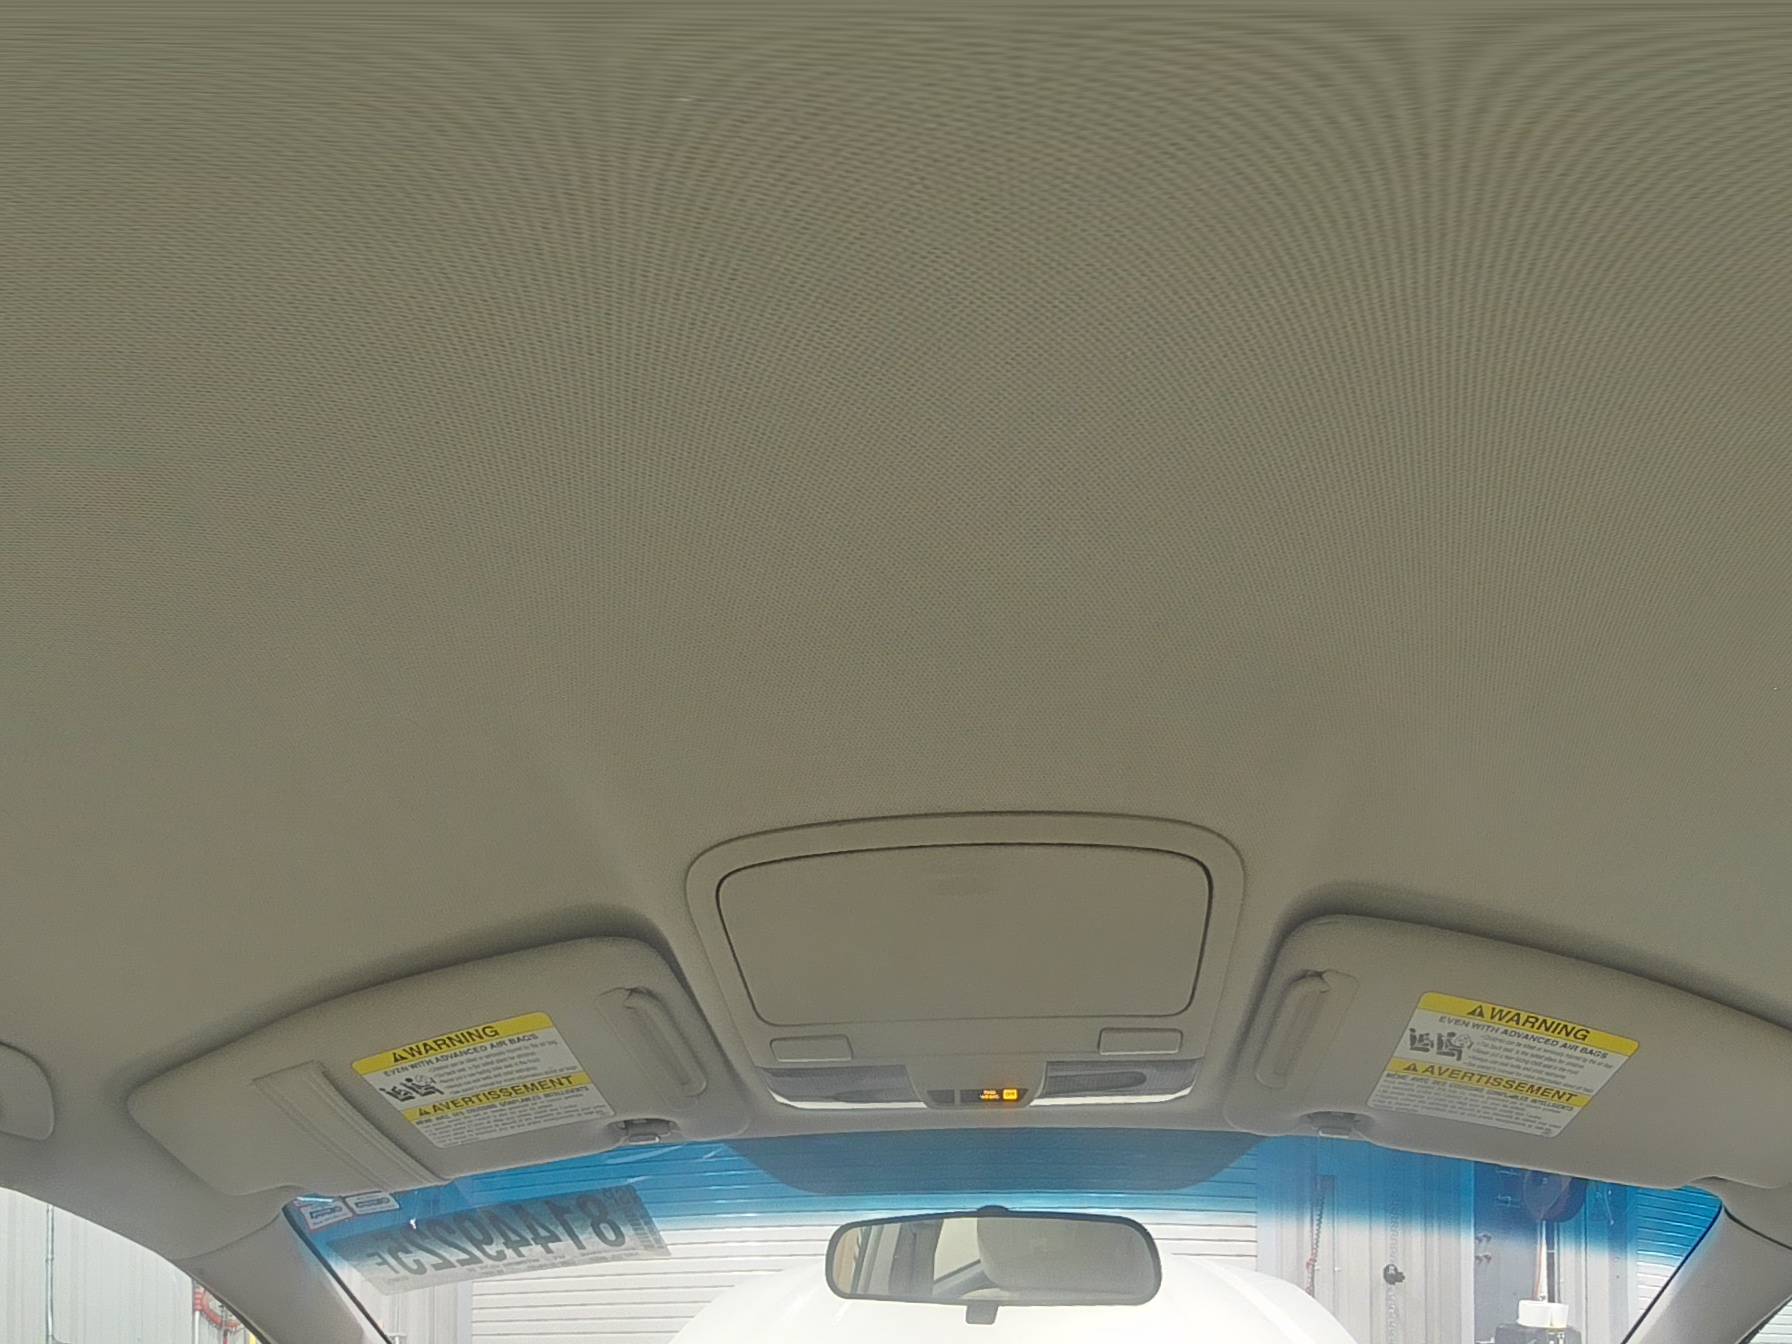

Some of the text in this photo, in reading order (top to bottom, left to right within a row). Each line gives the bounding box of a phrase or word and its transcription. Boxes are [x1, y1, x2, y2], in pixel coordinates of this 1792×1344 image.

[402, 1025, 501, 1058] WARNING
[1438, 1016, 1608, 1059] EVEN WITH ADVANCED AIR BAGS
[1488, 1007, 1591, 1041] WARNING
[432, 1044, 489, 1064] ADVANCED
[487, 1039, 509, 1050] AIR
[506, 1031, 539, 1045] BAGS
[429, 1074, 575, 1112] AVERTISSEMENT
[1422, 1064, 1578, 1102] AVERTISSEMENT
